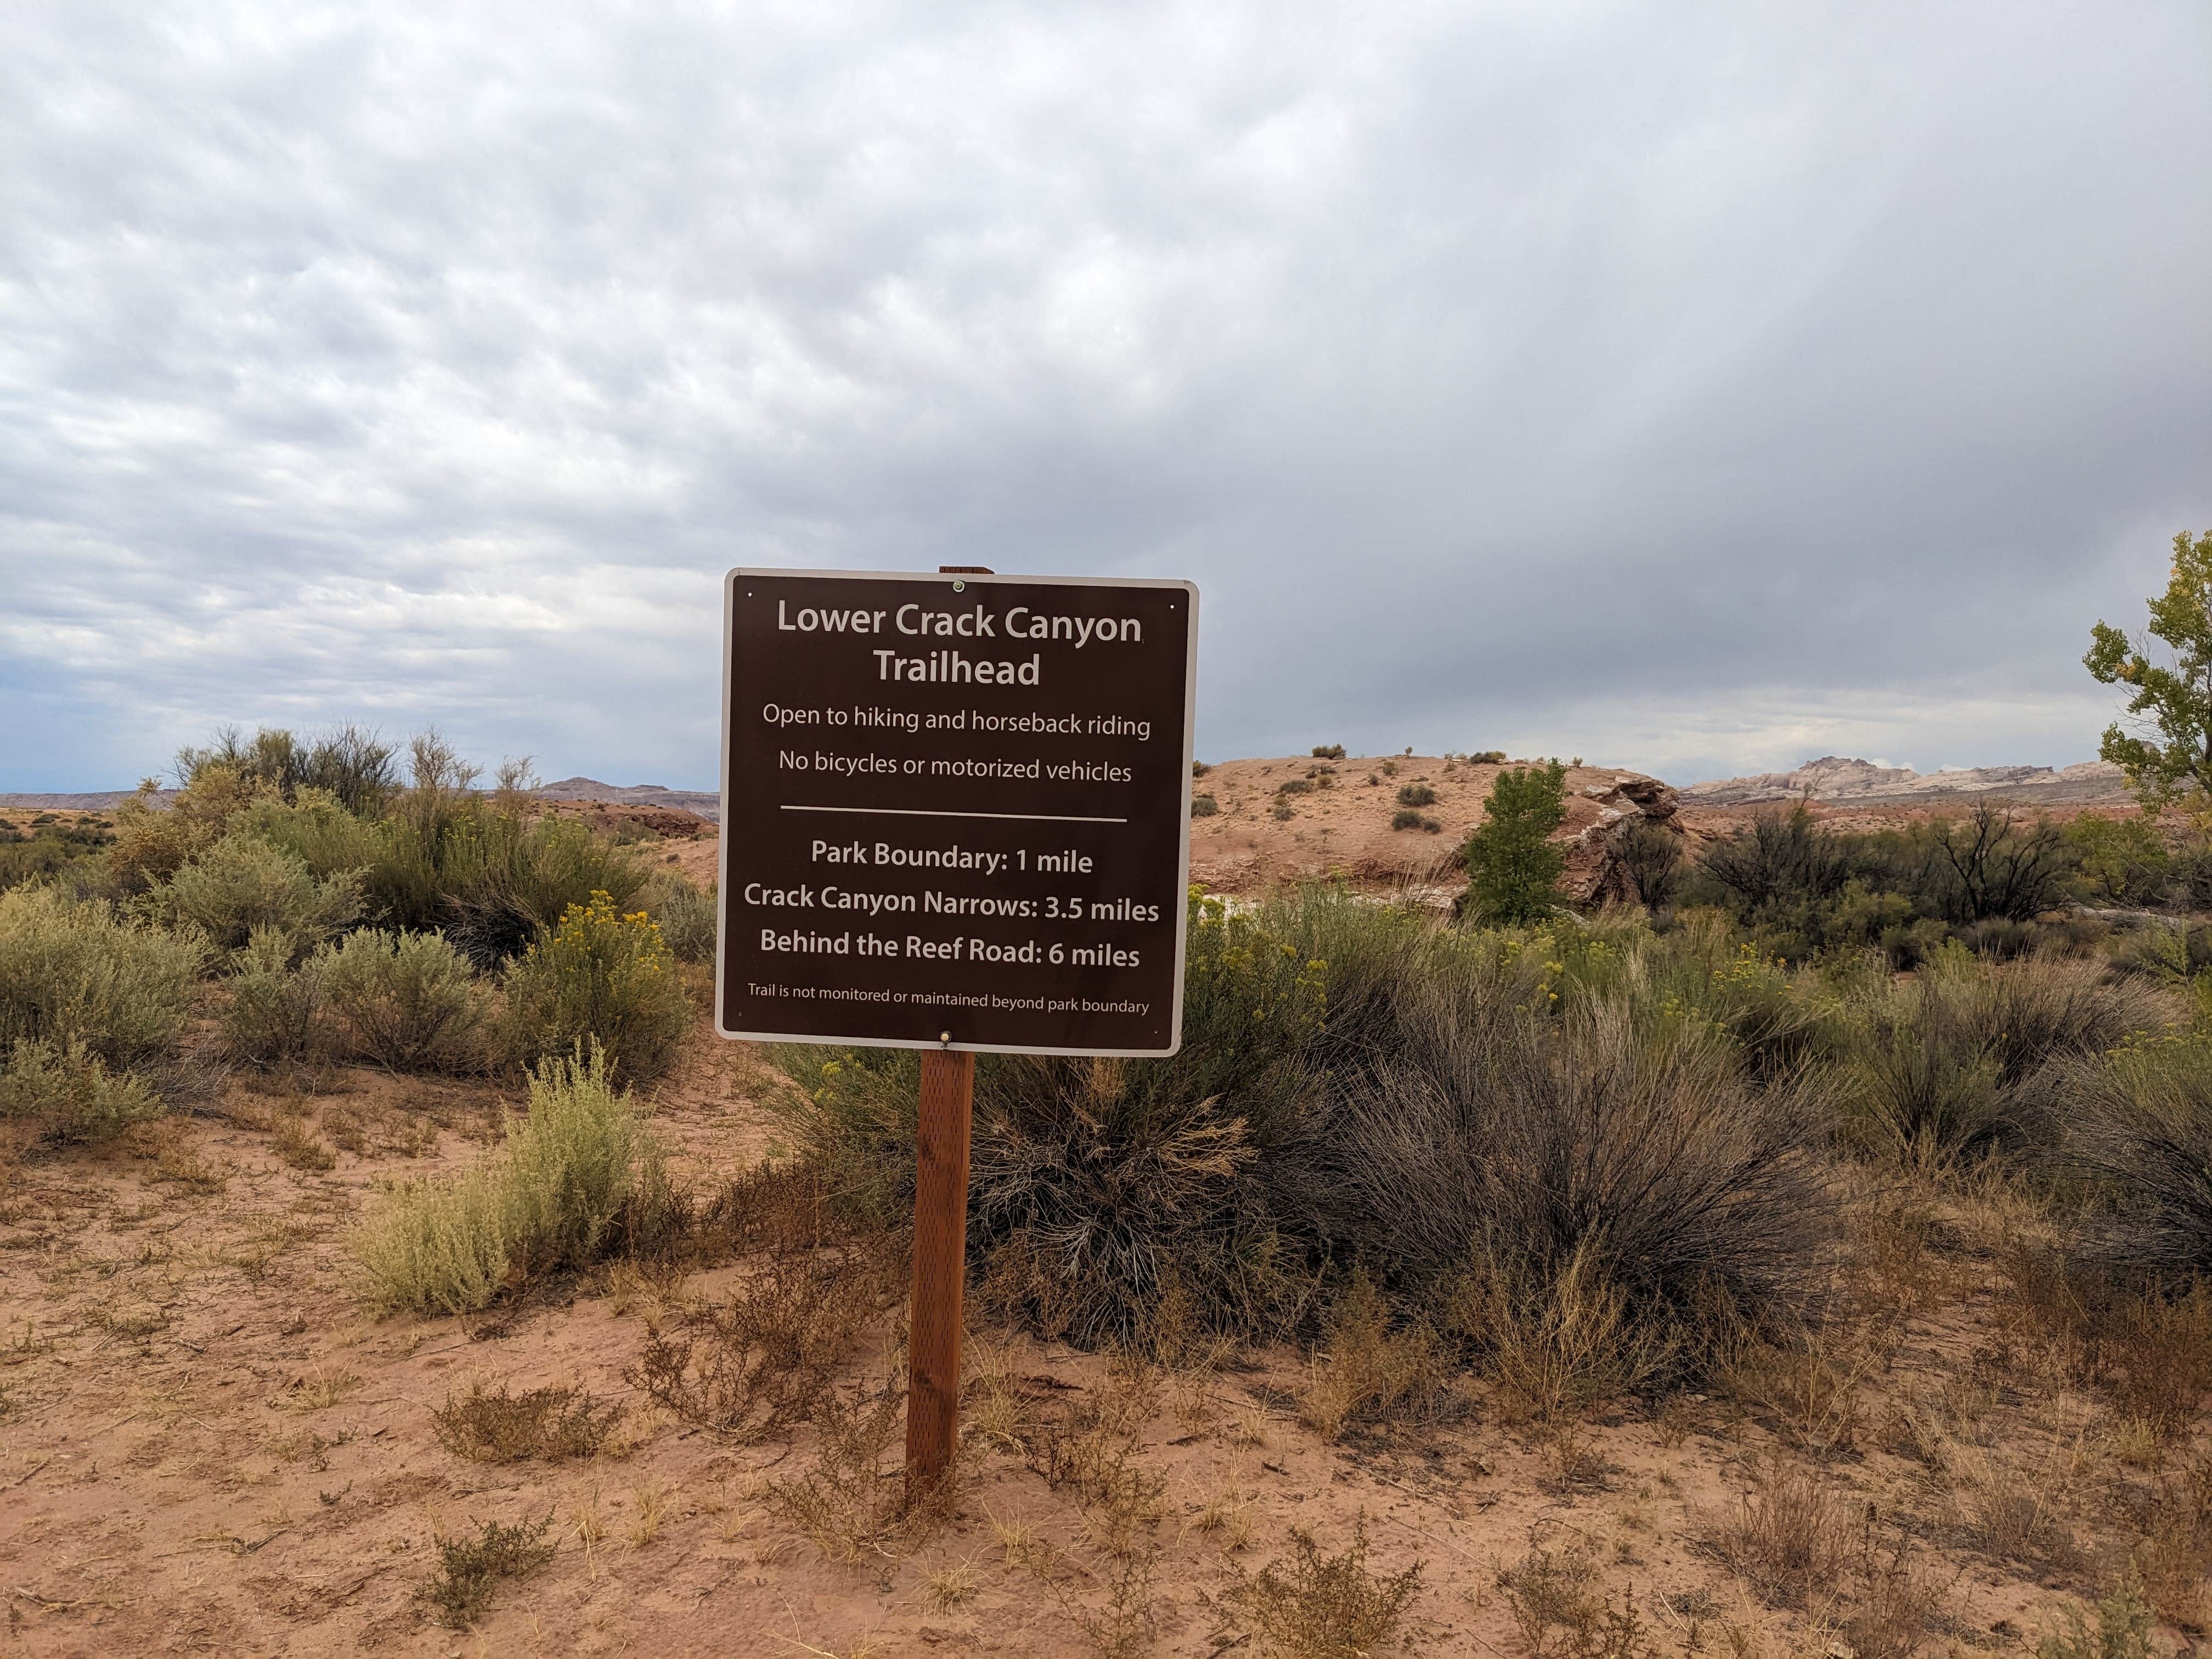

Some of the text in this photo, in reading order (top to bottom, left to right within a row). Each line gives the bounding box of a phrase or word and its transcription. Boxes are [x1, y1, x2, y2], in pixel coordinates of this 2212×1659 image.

[779, 600, 1140, 648] Lower Crack Canyon
[873, 650, 1039, 685] Trailhead
[764, 704, 1149, 741] Open to hiking and horseback riding
[780, 751, 1131, 781] No bicycles or motorized vehicles
[812, 840, 1092, 875] Park Boundary: 1 mile
[745, 883, 1158, 921] Crack Canyon Narrows: 3.5 miles
[761, 929, 1139, 966] Behind the Reef Road: 6 miles
[748, 983, 1149, 1015] Trail is not monitored or maintained beyond park boundary
